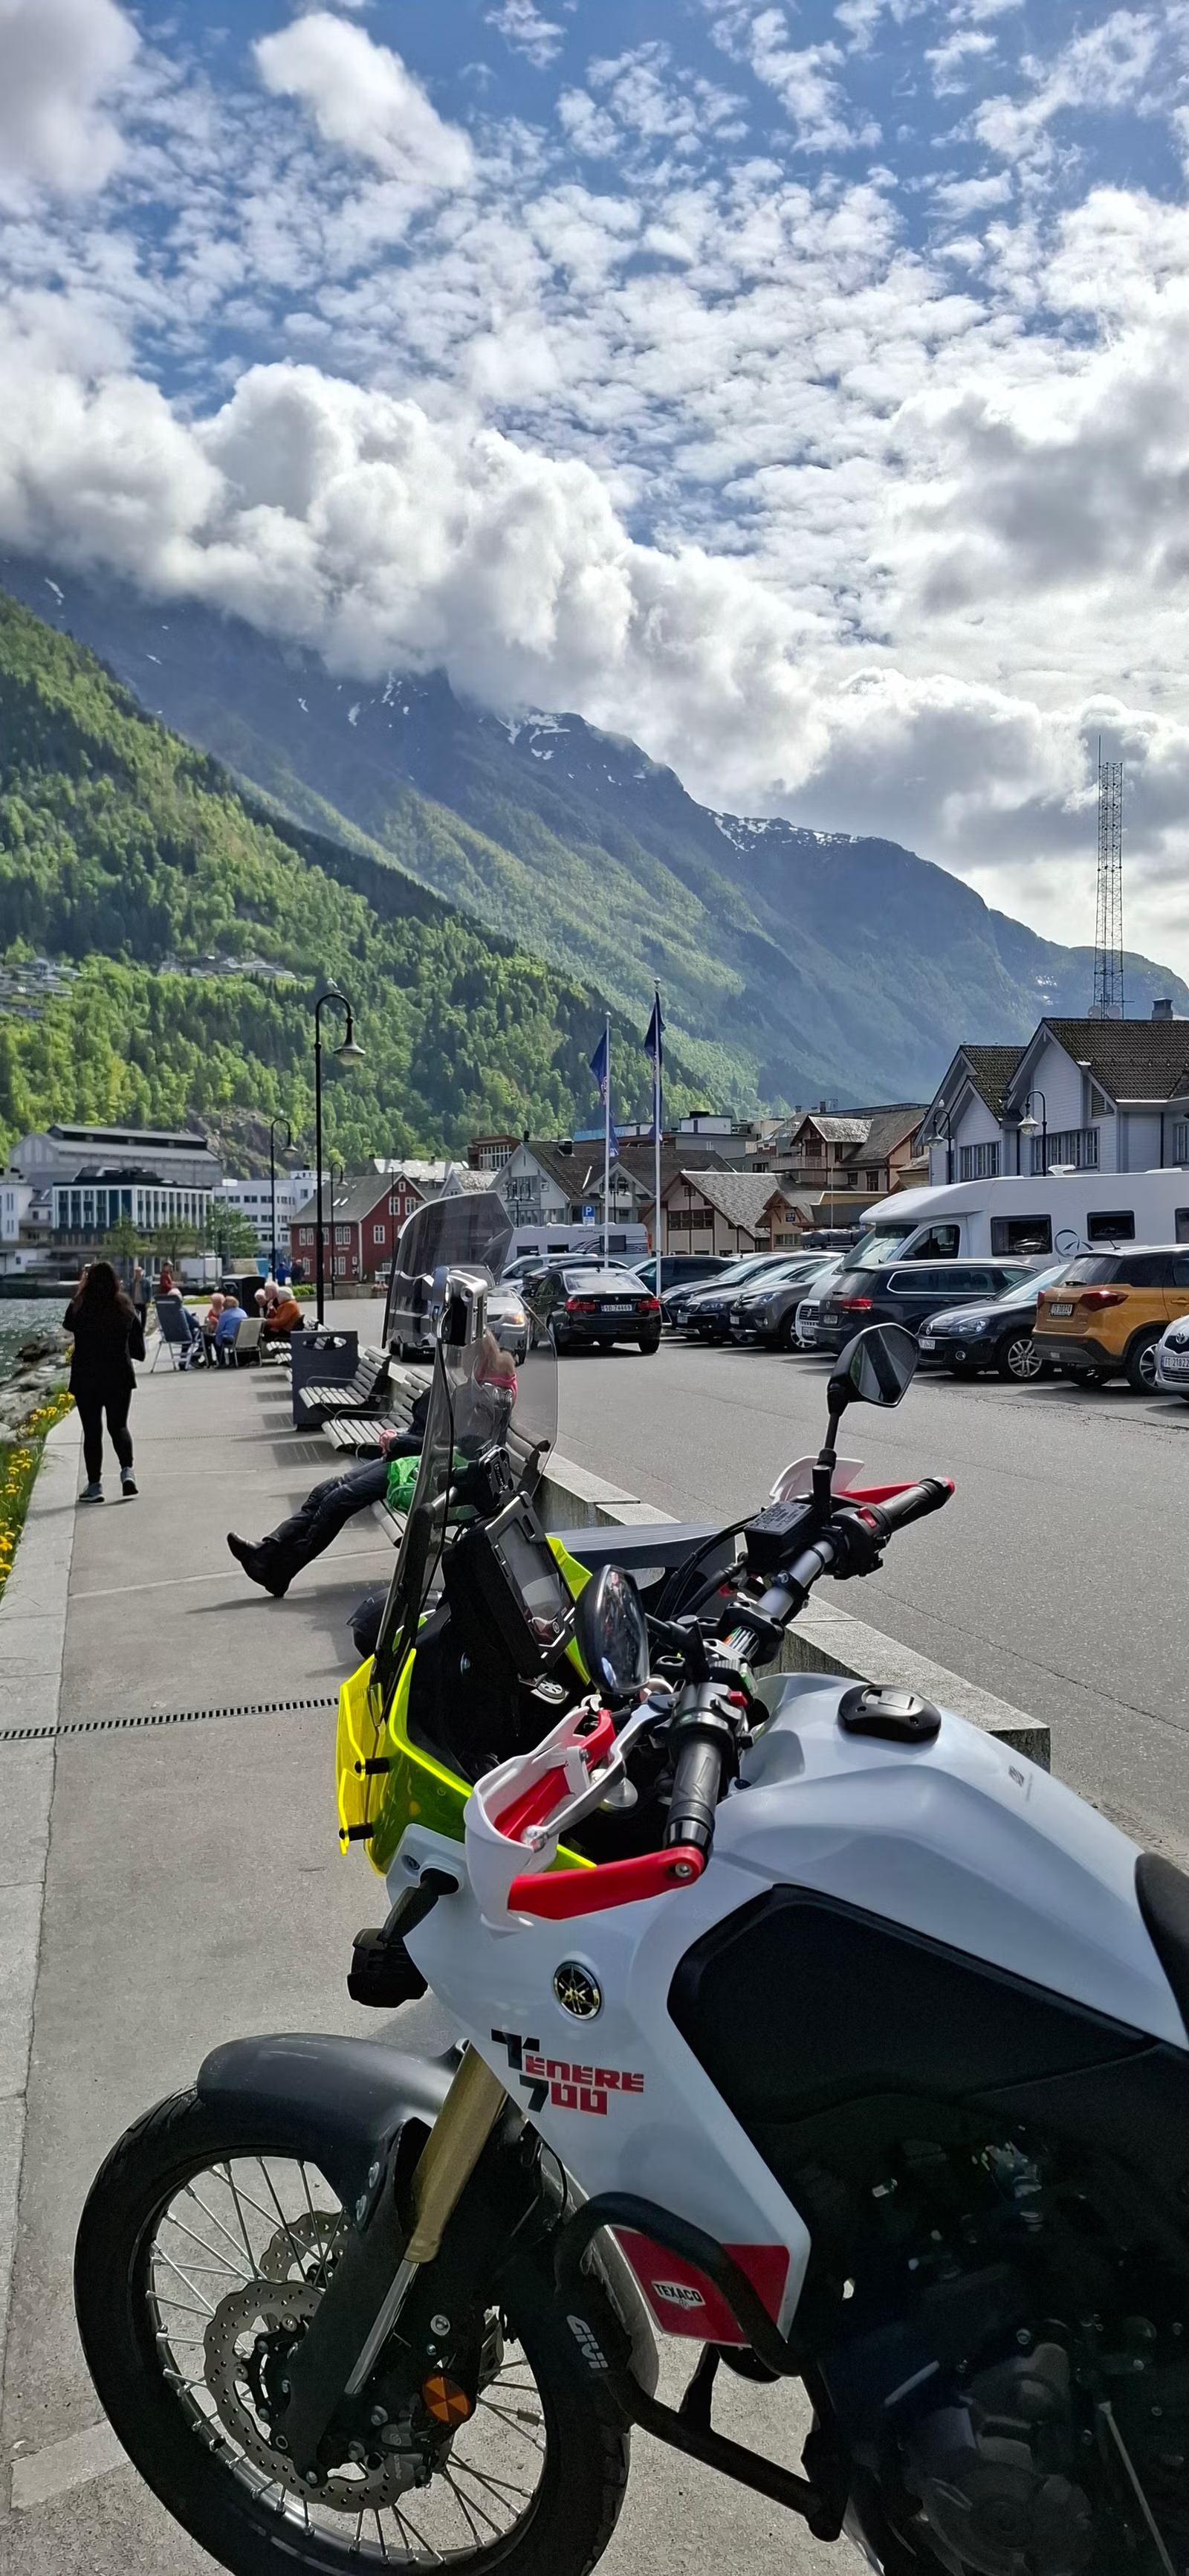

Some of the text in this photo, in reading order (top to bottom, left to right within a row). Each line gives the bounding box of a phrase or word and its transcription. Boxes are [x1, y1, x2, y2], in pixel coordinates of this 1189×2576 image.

[586, 1207, 592, 1216] P
[1172, 1358, 1189, 1367] 21822
[519, 2074, 608, 2115] 700
[654, 2284, 704, 2302] TEXACO
[566, 2315, 609, 2369] GIVI
